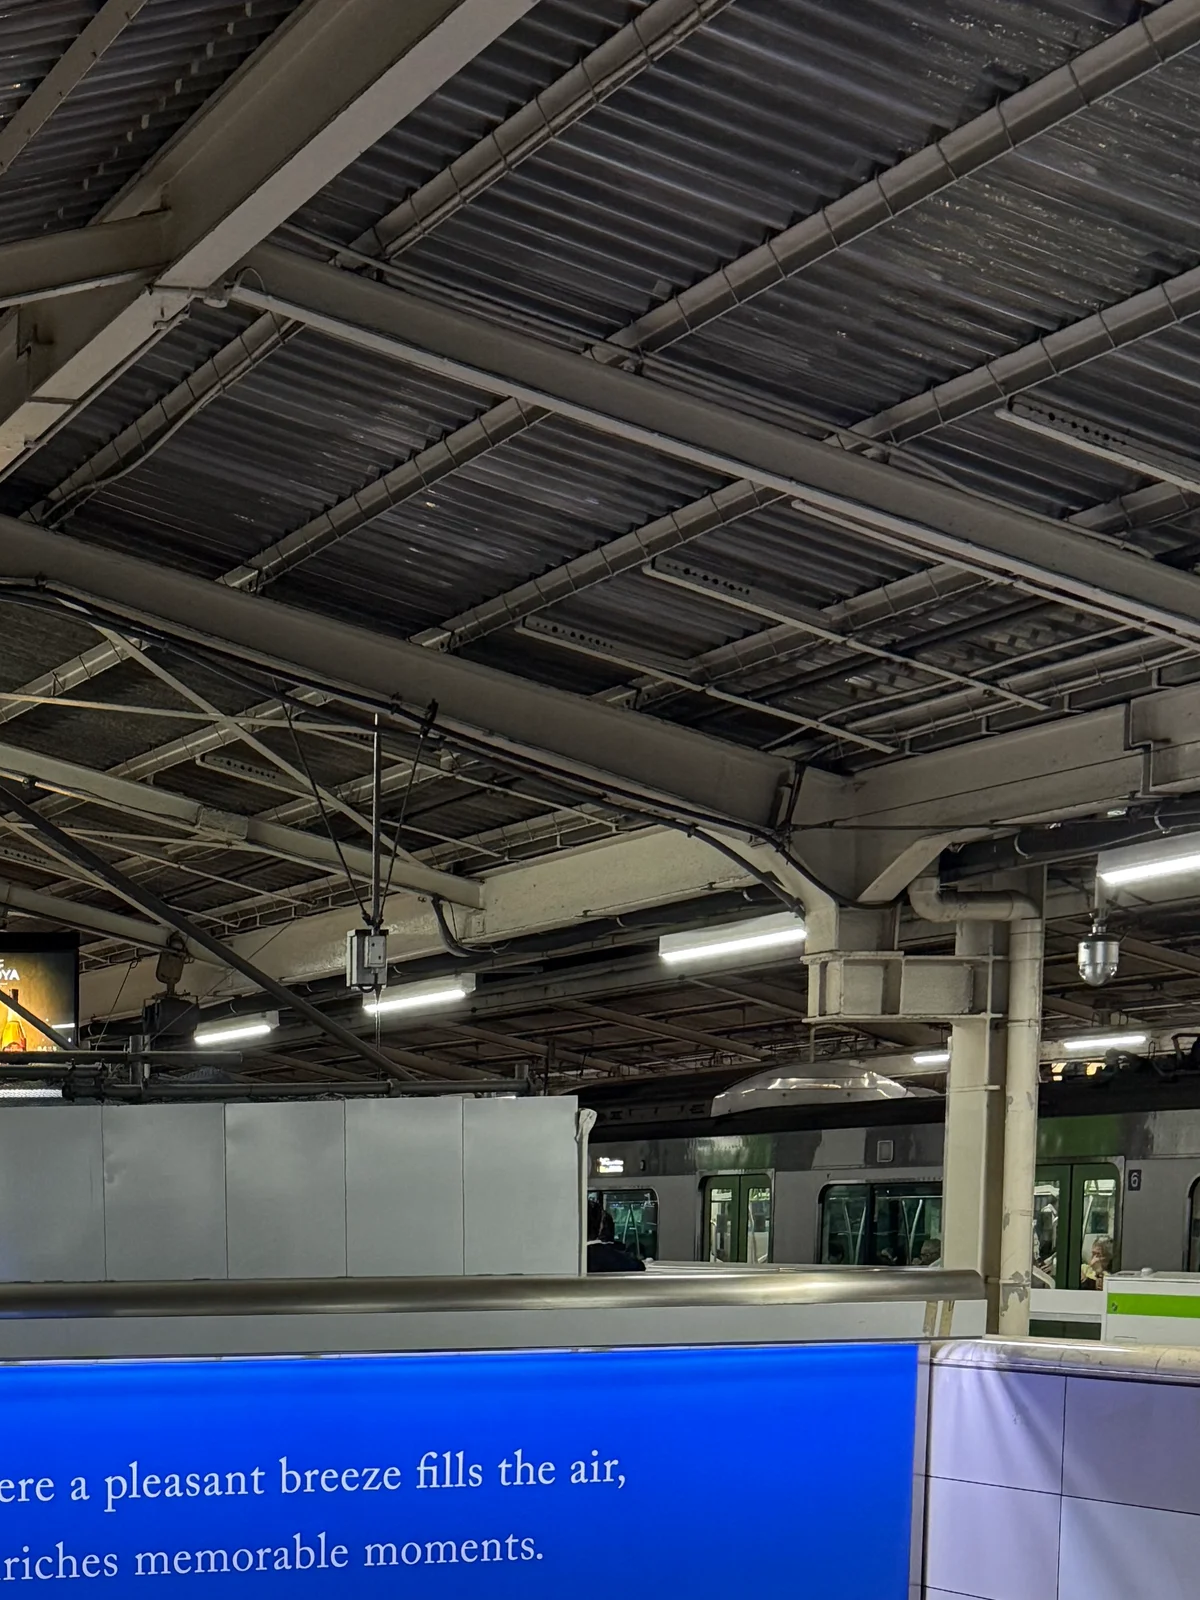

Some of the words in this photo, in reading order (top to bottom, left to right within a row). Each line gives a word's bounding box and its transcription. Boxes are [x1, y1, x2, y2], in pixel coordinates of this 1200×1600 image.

[1131, 1172, 1139, 1187] 6
[71, 1477, 89, 1501] a
[104, 1461, 265, 1512] pleasant
[279, 1457, 400, 1494] breeze
[416, 1451, 483, 1489] fills
[498, 1449, 556, 1486] the
[570, 1450, 626, 1489] air,
[135, 1532, 349, 1576] memorable
[364, 1534, 543, 1567] moments.
